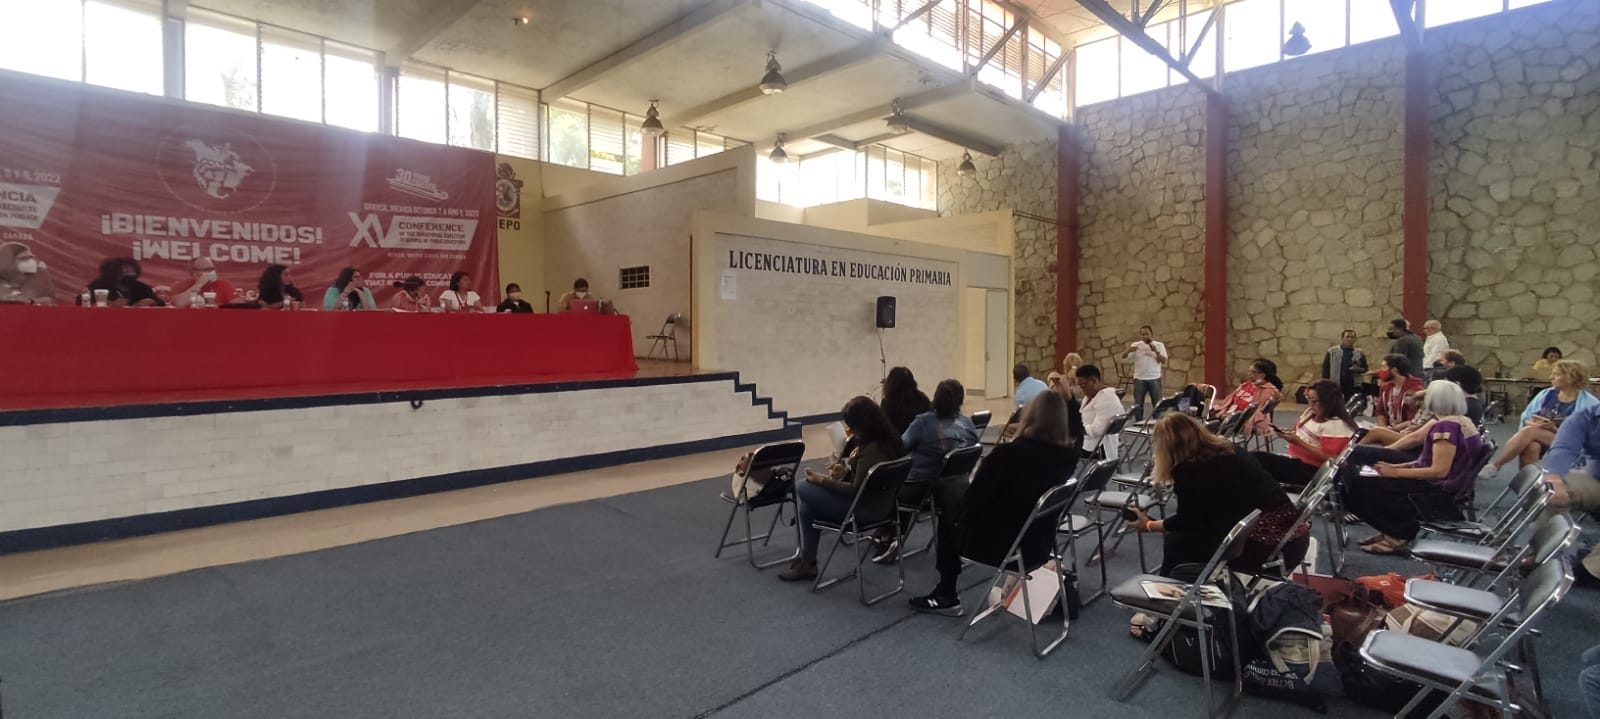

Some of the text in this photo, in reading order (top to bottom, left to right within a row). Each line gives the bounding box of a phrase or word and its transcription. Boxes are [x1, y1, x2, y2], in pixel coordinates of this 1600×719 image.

[101, 212, 323, 245] ¡BIENVENIDOS!
[398, 221, 465, 232] CONFERENCE
[498, 218, 521, 231] EPO
[728, 250, 952, 286] LICENCIATURA EN EDUCACIÓN PRIMARIA
[423, 272, 452, 280] EDUCAT
